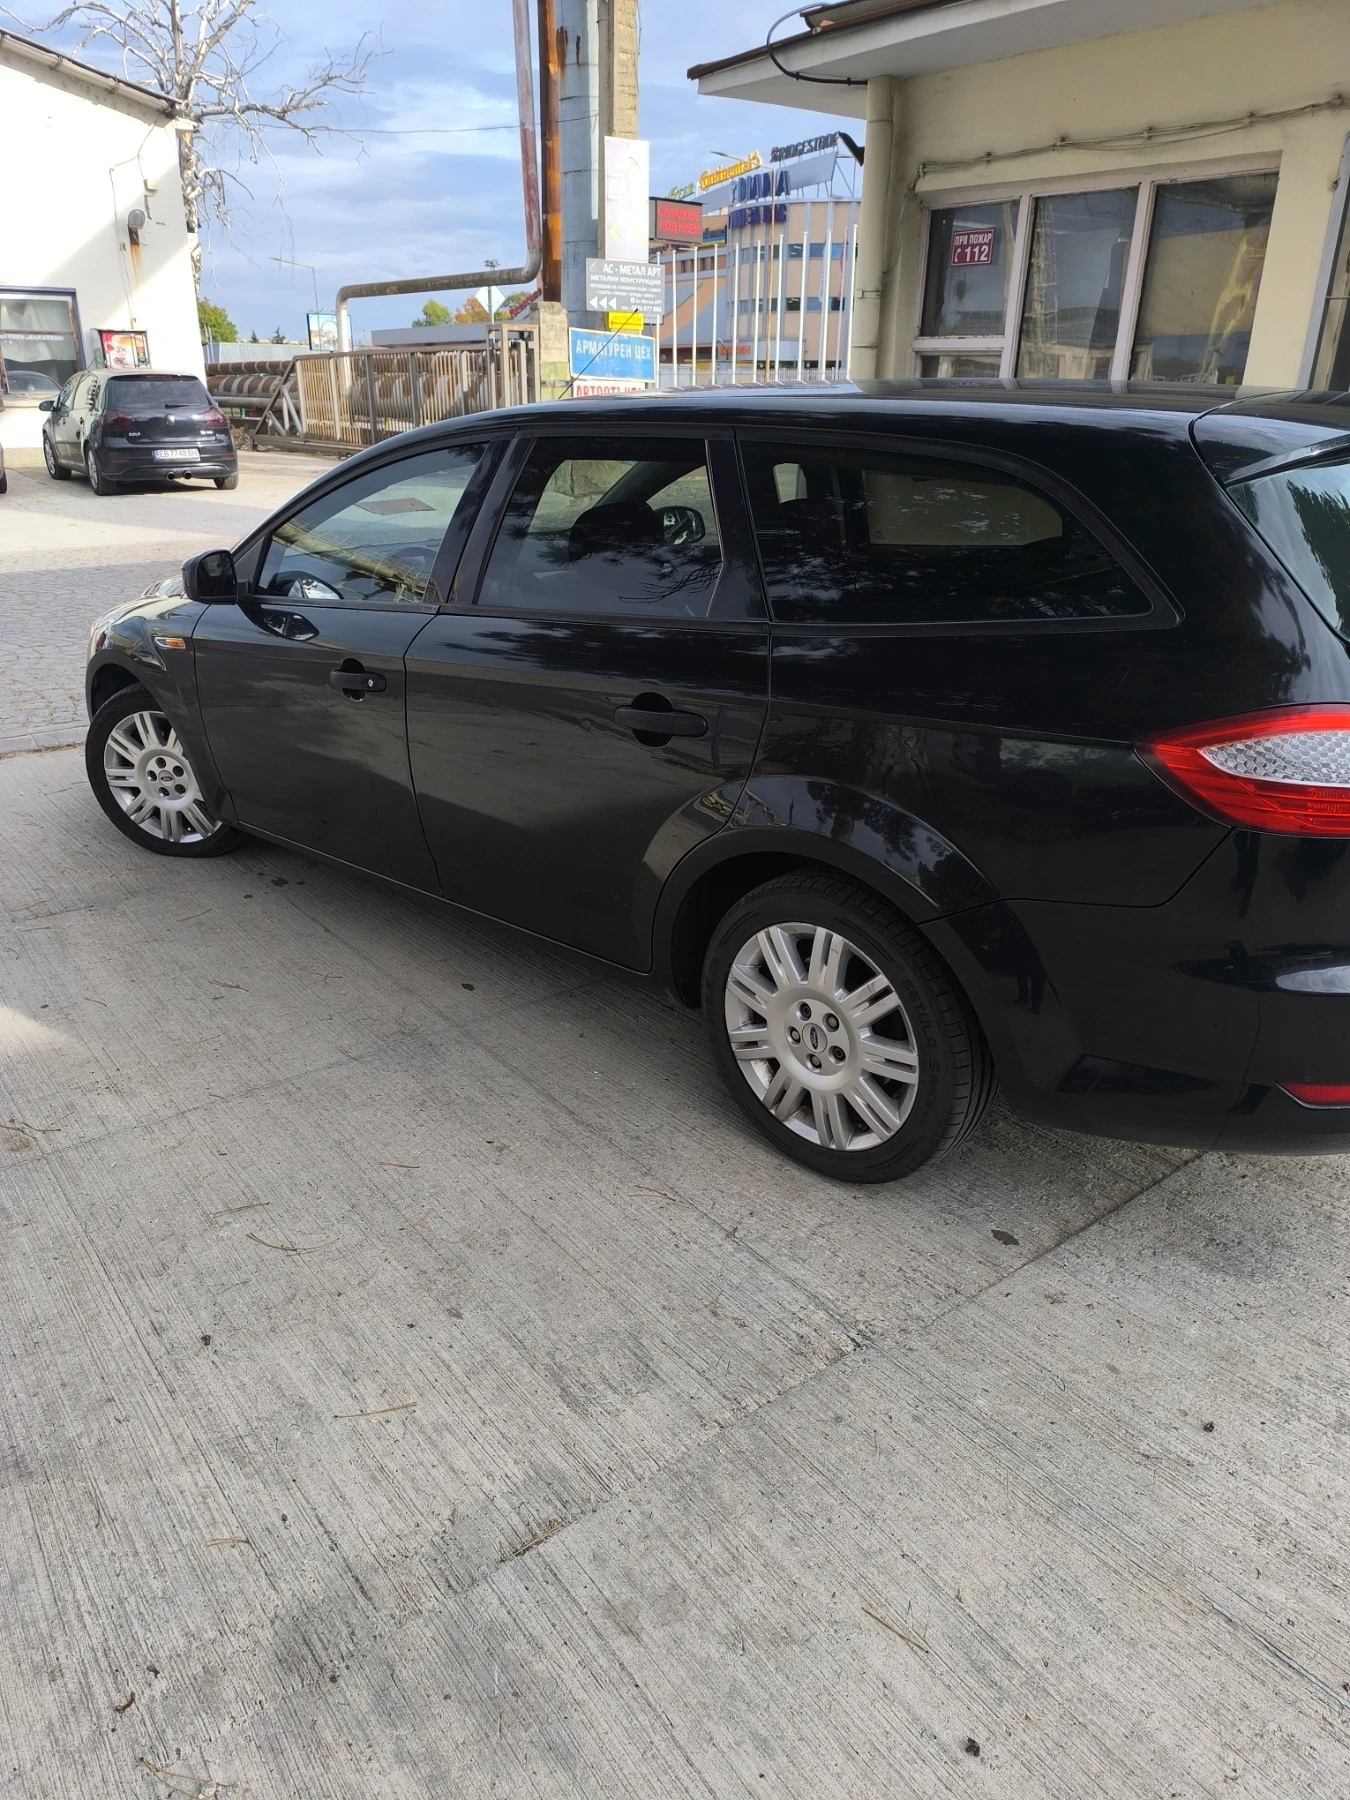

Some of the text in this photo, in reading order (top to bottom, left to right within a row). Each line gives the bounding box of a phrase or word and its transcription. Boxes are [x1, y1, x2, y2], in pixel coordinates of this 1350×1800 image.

[699, 153, 754, 192] Continental
[658, 205, 700, 221] СКЛАДОВЕ
[659, 219, 678, 234] ПОД
[955, 233, 992, 246] ПРИ ПОЖАР
[965, 245, 989, 262] 112
[603, 263, 614, 274] АС
[620, 264, 646, 277] МЕТАЛ
[647, 267, 662, 277] АРТ
[590, 274, 662, 286] МЕТАЛНИ КОНСТРУКЦИИ
[576, 338, 652, 361] АРМАТУРЕН ЦЕХ
[901, 979, 937, 1048] SETULA
